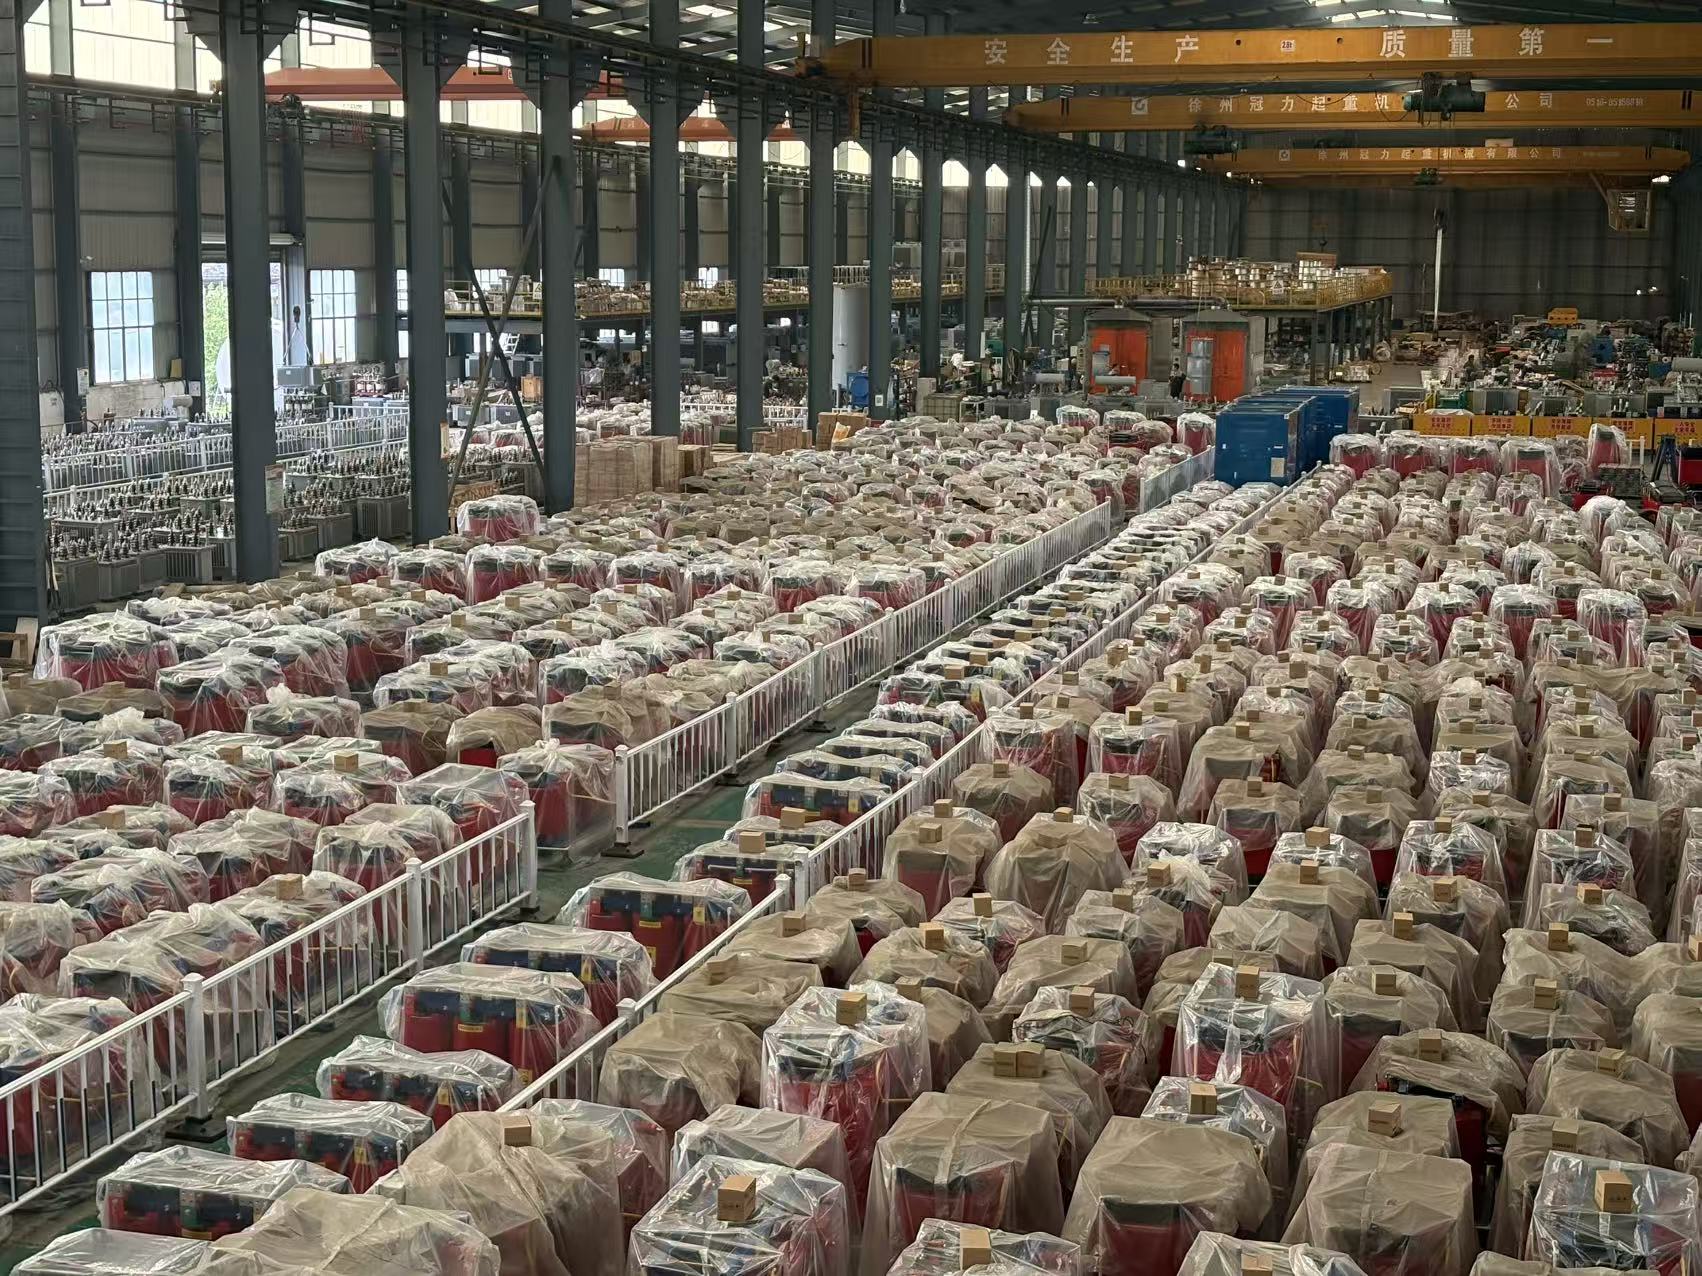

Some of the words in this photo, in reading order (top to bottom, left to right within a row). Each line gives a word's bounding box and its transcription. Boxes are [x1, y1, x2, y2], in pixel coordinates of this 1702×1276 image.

[984, 35, 1199, 65] 安全生产
[1379, 27, 1613, 58] 质量第一
